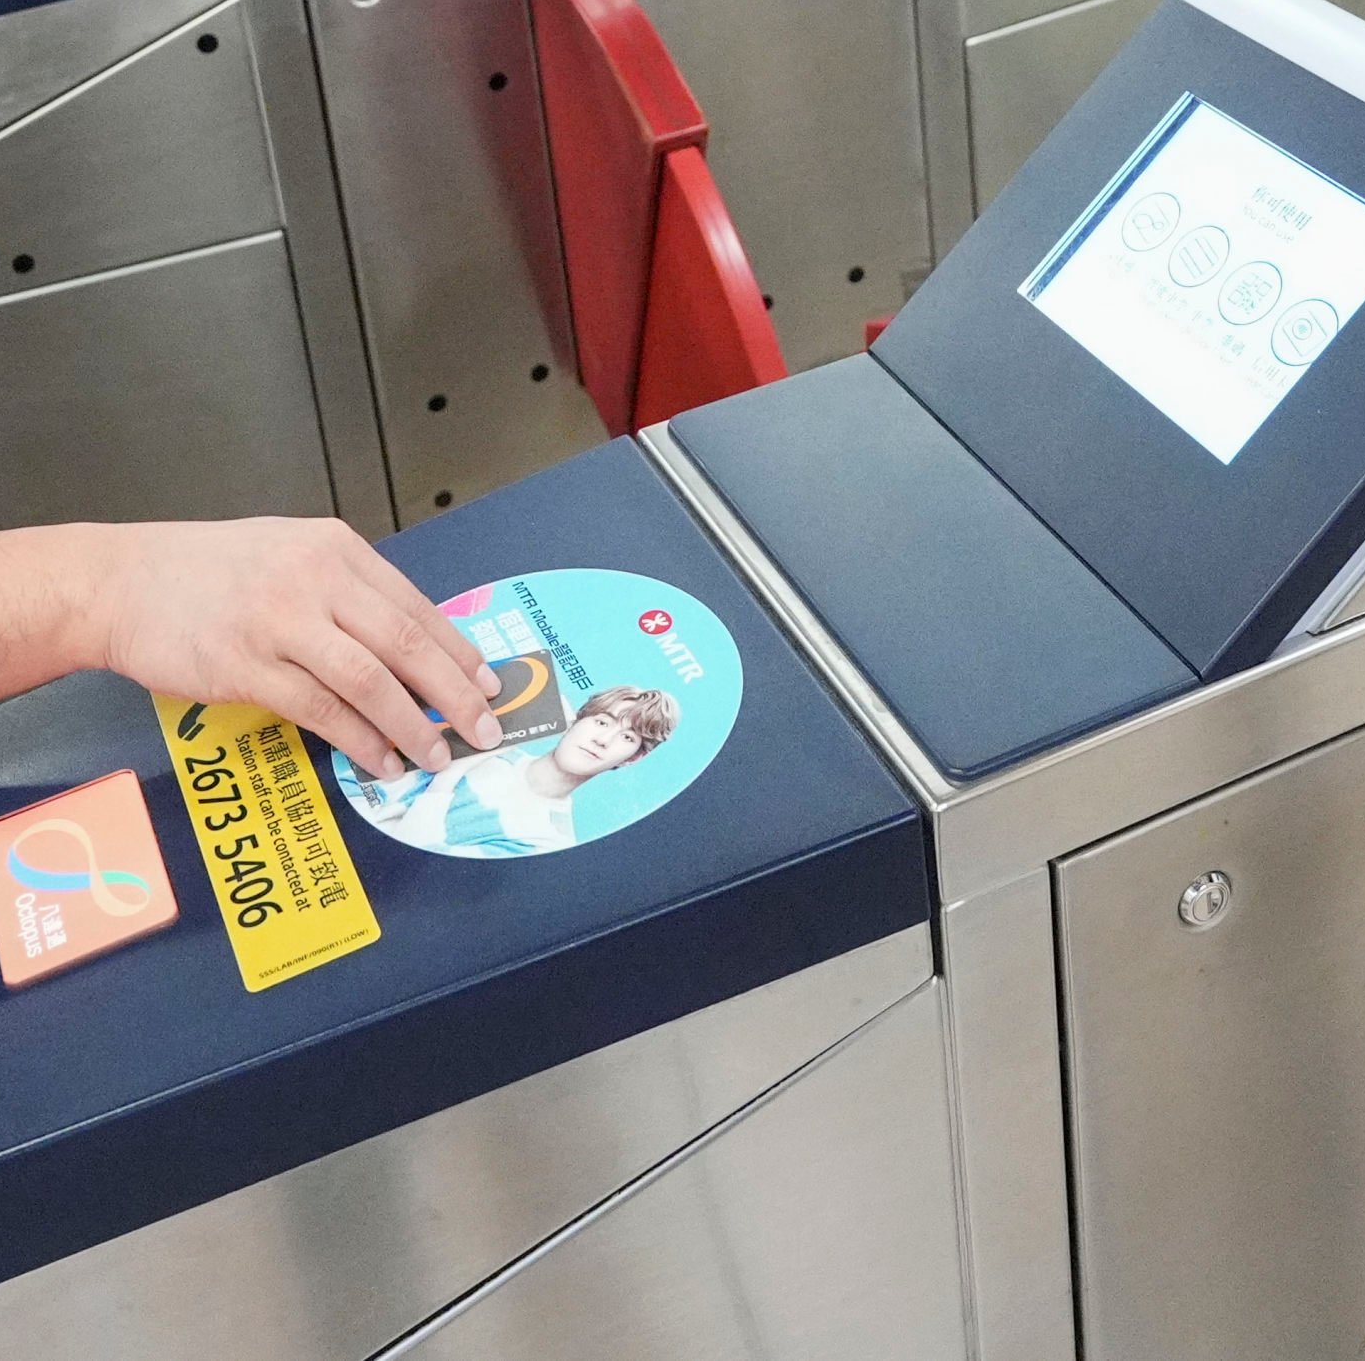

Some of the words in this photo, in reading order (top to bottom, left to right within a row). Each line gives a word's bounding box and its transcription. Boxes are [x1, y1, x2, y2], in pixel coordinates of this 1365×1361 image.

[512, 581, 538, 609] MTR
[654, 631, 708, 685] MTR
[235, 733, 257, 773] Station
[185, 745, 248, 832] 2673
[249, 769, 274, 798] staff
[255, 723, 350, 909] 如需職員協助可致電
[258, 797, 276, 820] can
[267, 817, 285, 837] be
[214, 833, 284, 929] 5406
[273, 836, 309, 896] contacted
[15, 892, 43, 959] Octopus
[295, 895, 312, 913] at
